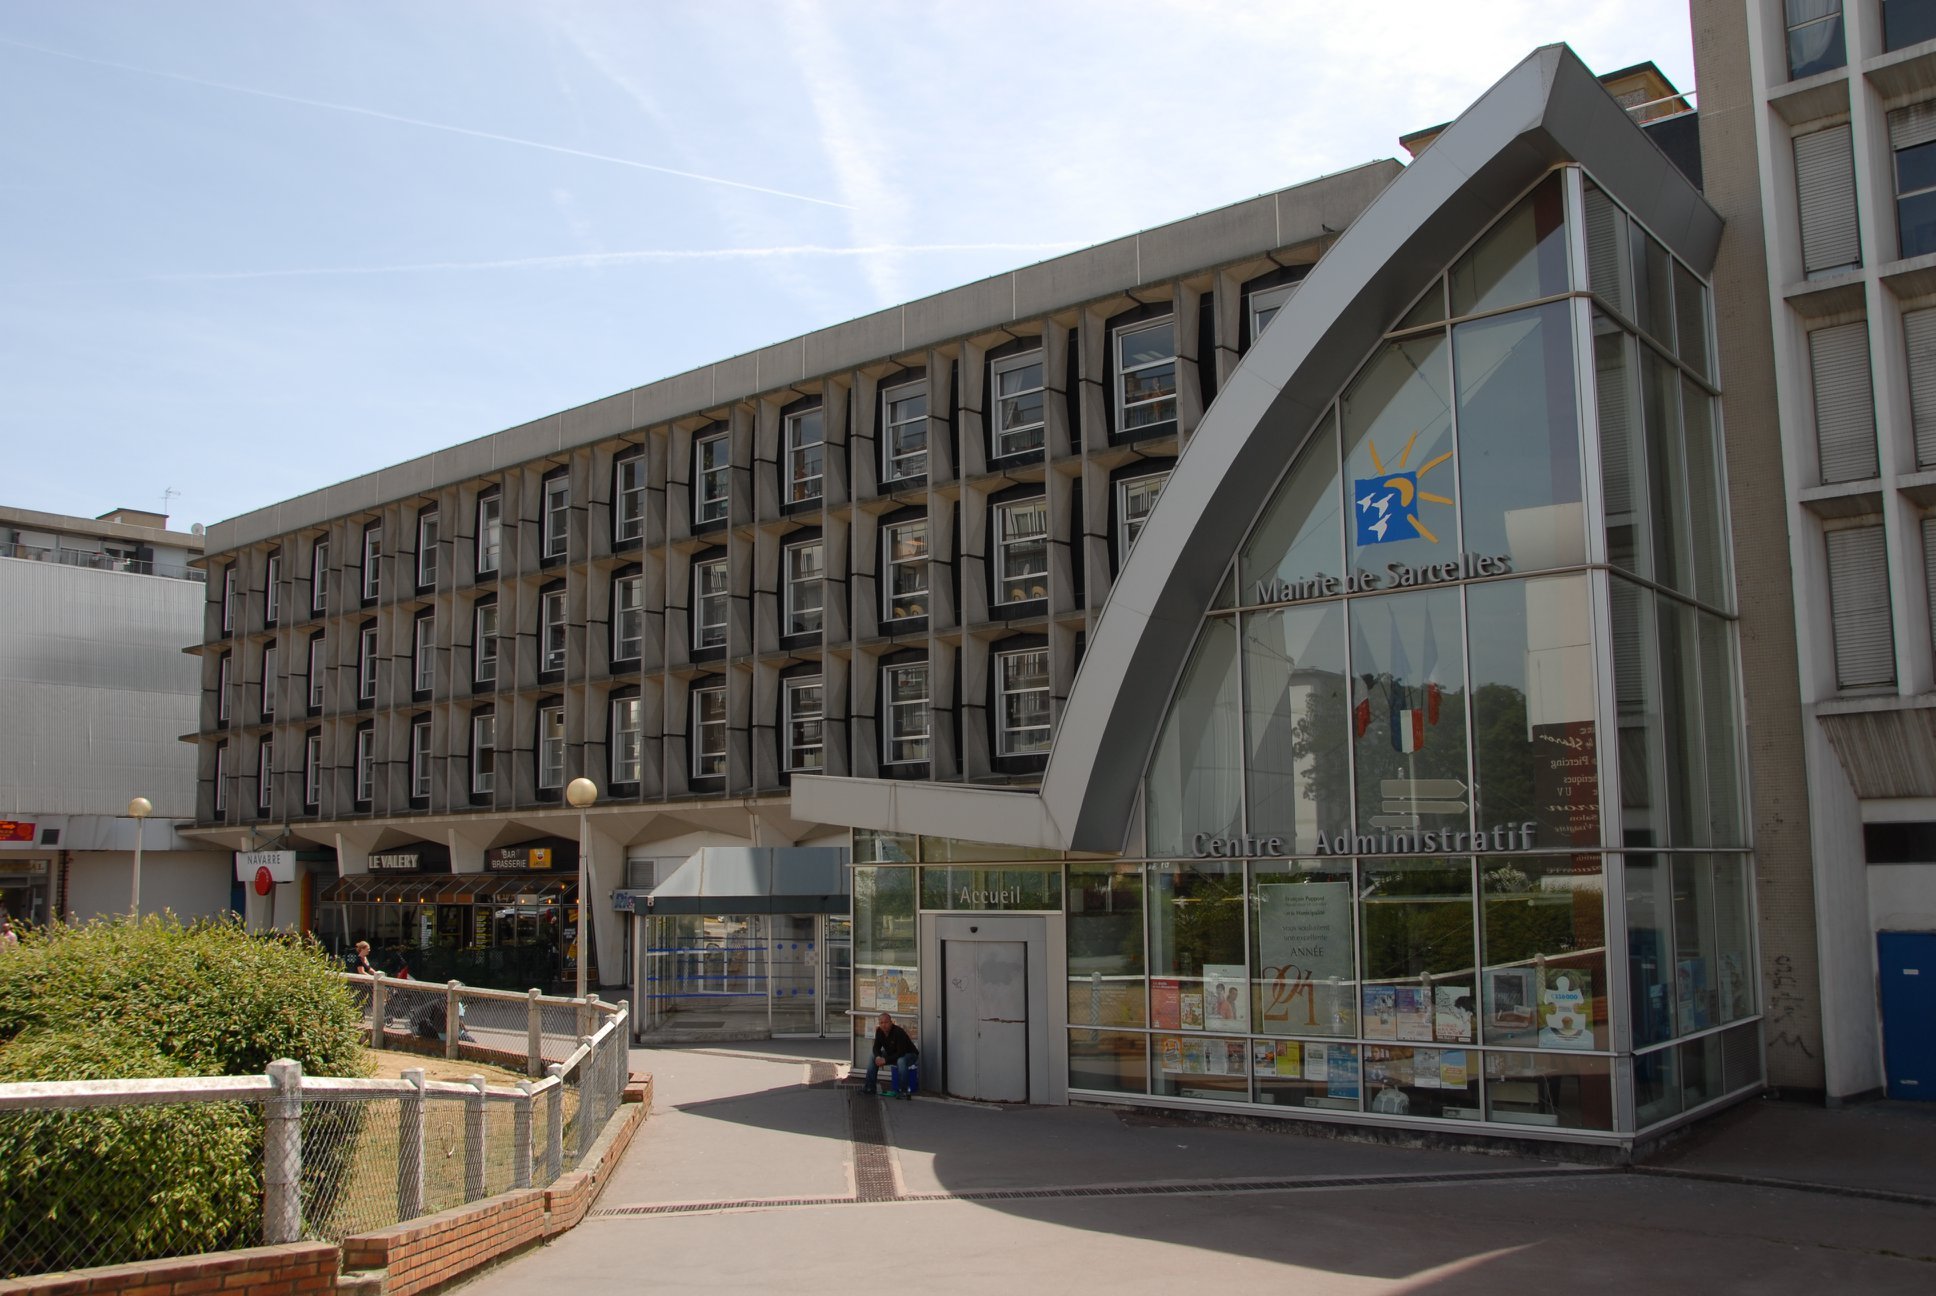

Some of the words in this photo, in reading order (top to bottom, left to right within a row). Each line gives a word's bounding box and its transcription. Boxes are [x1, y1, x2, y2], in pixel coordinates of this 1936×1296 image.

[1255, 572, 1340, 605] Mairie
[1344, 568, 1380, 596] de
[1386, 552, 1511, 589] Sarcelles
[1192, 832, 1286, 858] Centre
[1313, 821, 1537, 856] Administratif
[247, 854, 281, 866] NAVARRE
[368, 855, 381, 869] LE
[381, 854, 418, 869] VALERY
[502, 850, 516, 859] BAR
[491, 858, 527, 869] BRASSERIE
[959, 885, 1021, 904] Accueil
[1290, 944, 1324, 957] ANNÉE
